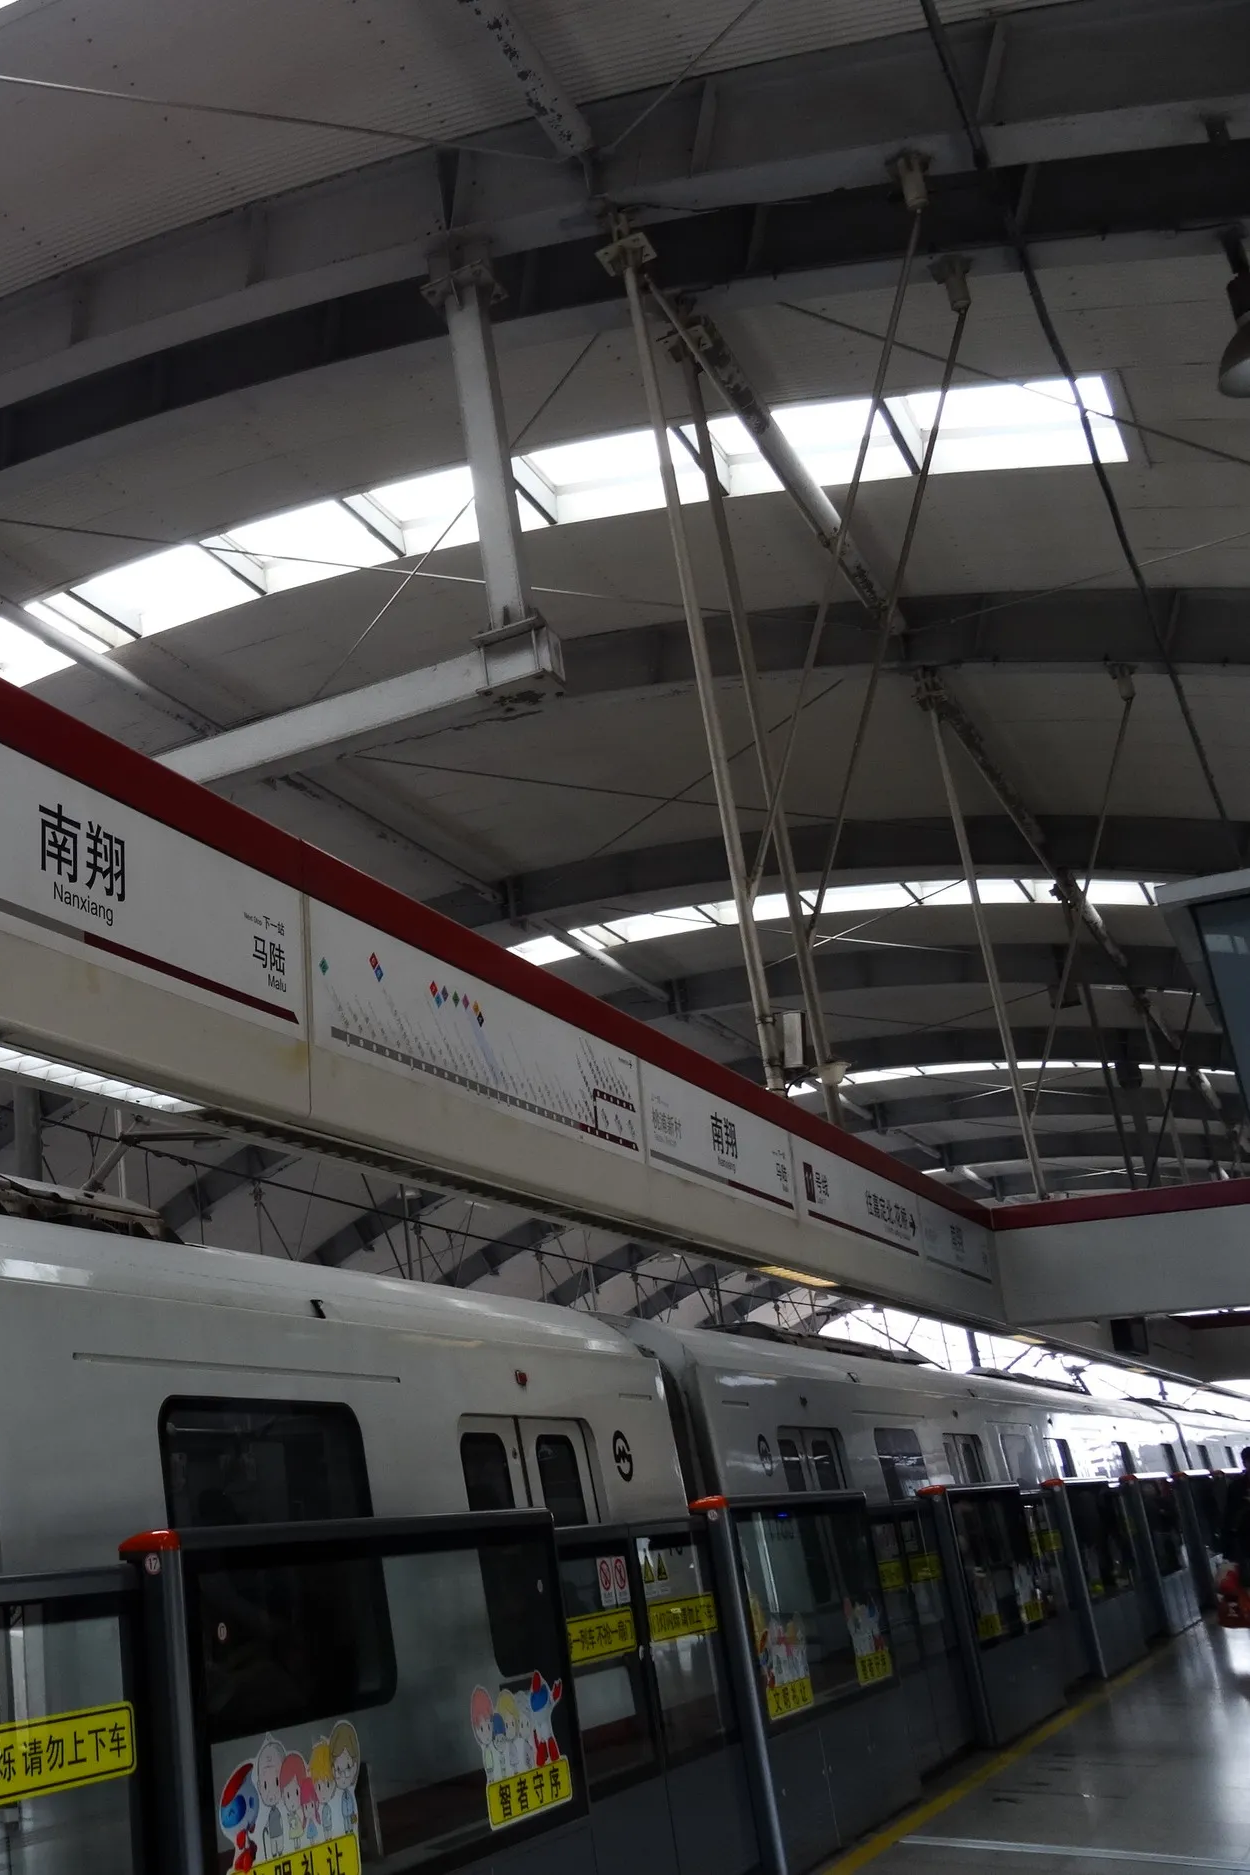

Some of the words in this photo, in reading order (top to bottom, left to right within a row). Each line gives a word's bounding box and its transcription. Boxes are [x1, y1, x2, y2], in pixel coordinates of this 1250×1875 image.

[39, 803, 125, 902] 南翔
[53, 881, 114, 927] Nanxiang
[263, 915, 285, 936] 下一站
[253, 935, 286, 976] 马陆
[268, 973, 287, 993] Malu
[710, 1111, 738, 1159] 南翔
[567, 1619, 634, 1658] 一列车不抢一扇门
[253, 1842, 346, 1875] 礼让
